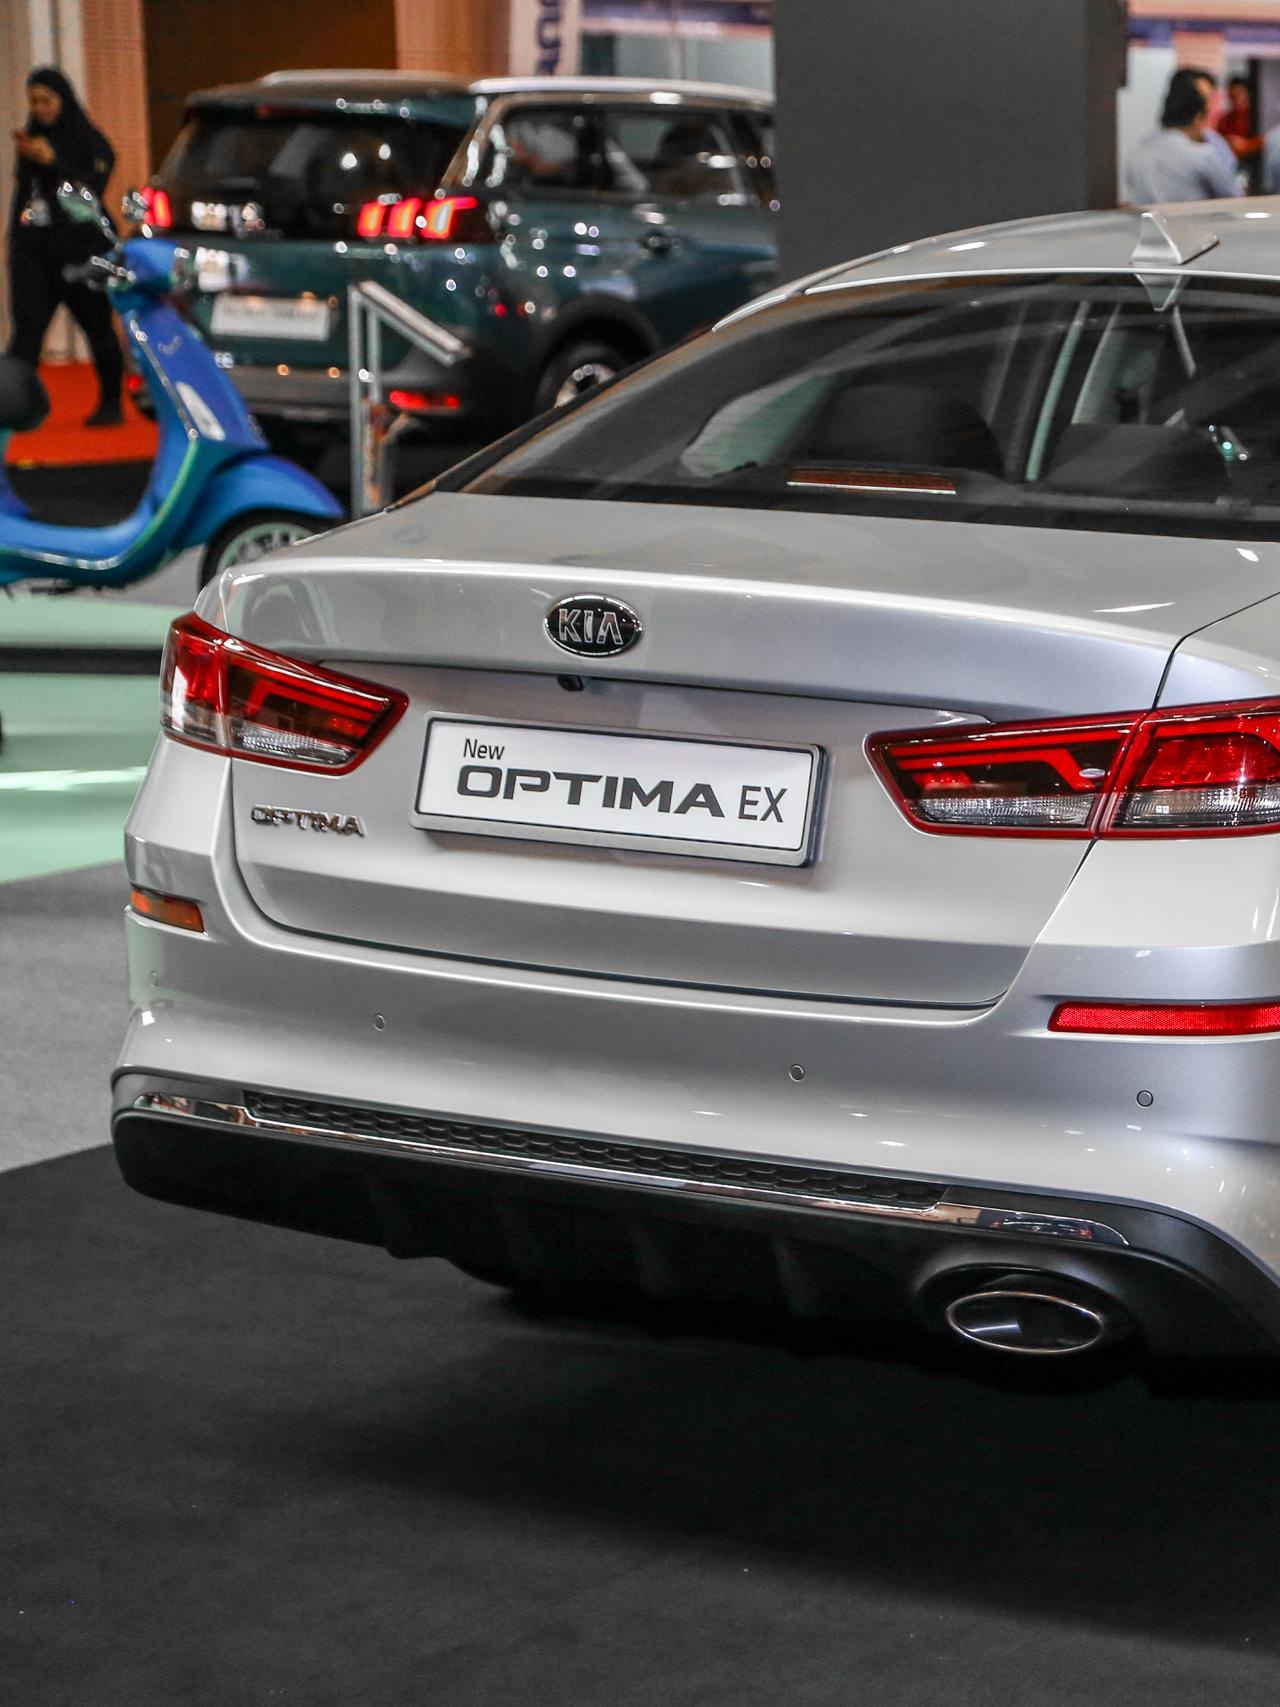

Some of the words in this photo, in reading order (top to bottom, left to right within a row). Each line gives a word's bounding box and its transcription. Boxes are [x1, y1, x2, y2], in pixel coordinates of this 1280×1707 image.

[558, 608, 624, 645] KIA
[463, 738, 504, 761] New
[457, 764, 725, 818] OPTIMA
[738, 785, 788, 823] EX
[251, 803, 367, 838] OPTIMA
